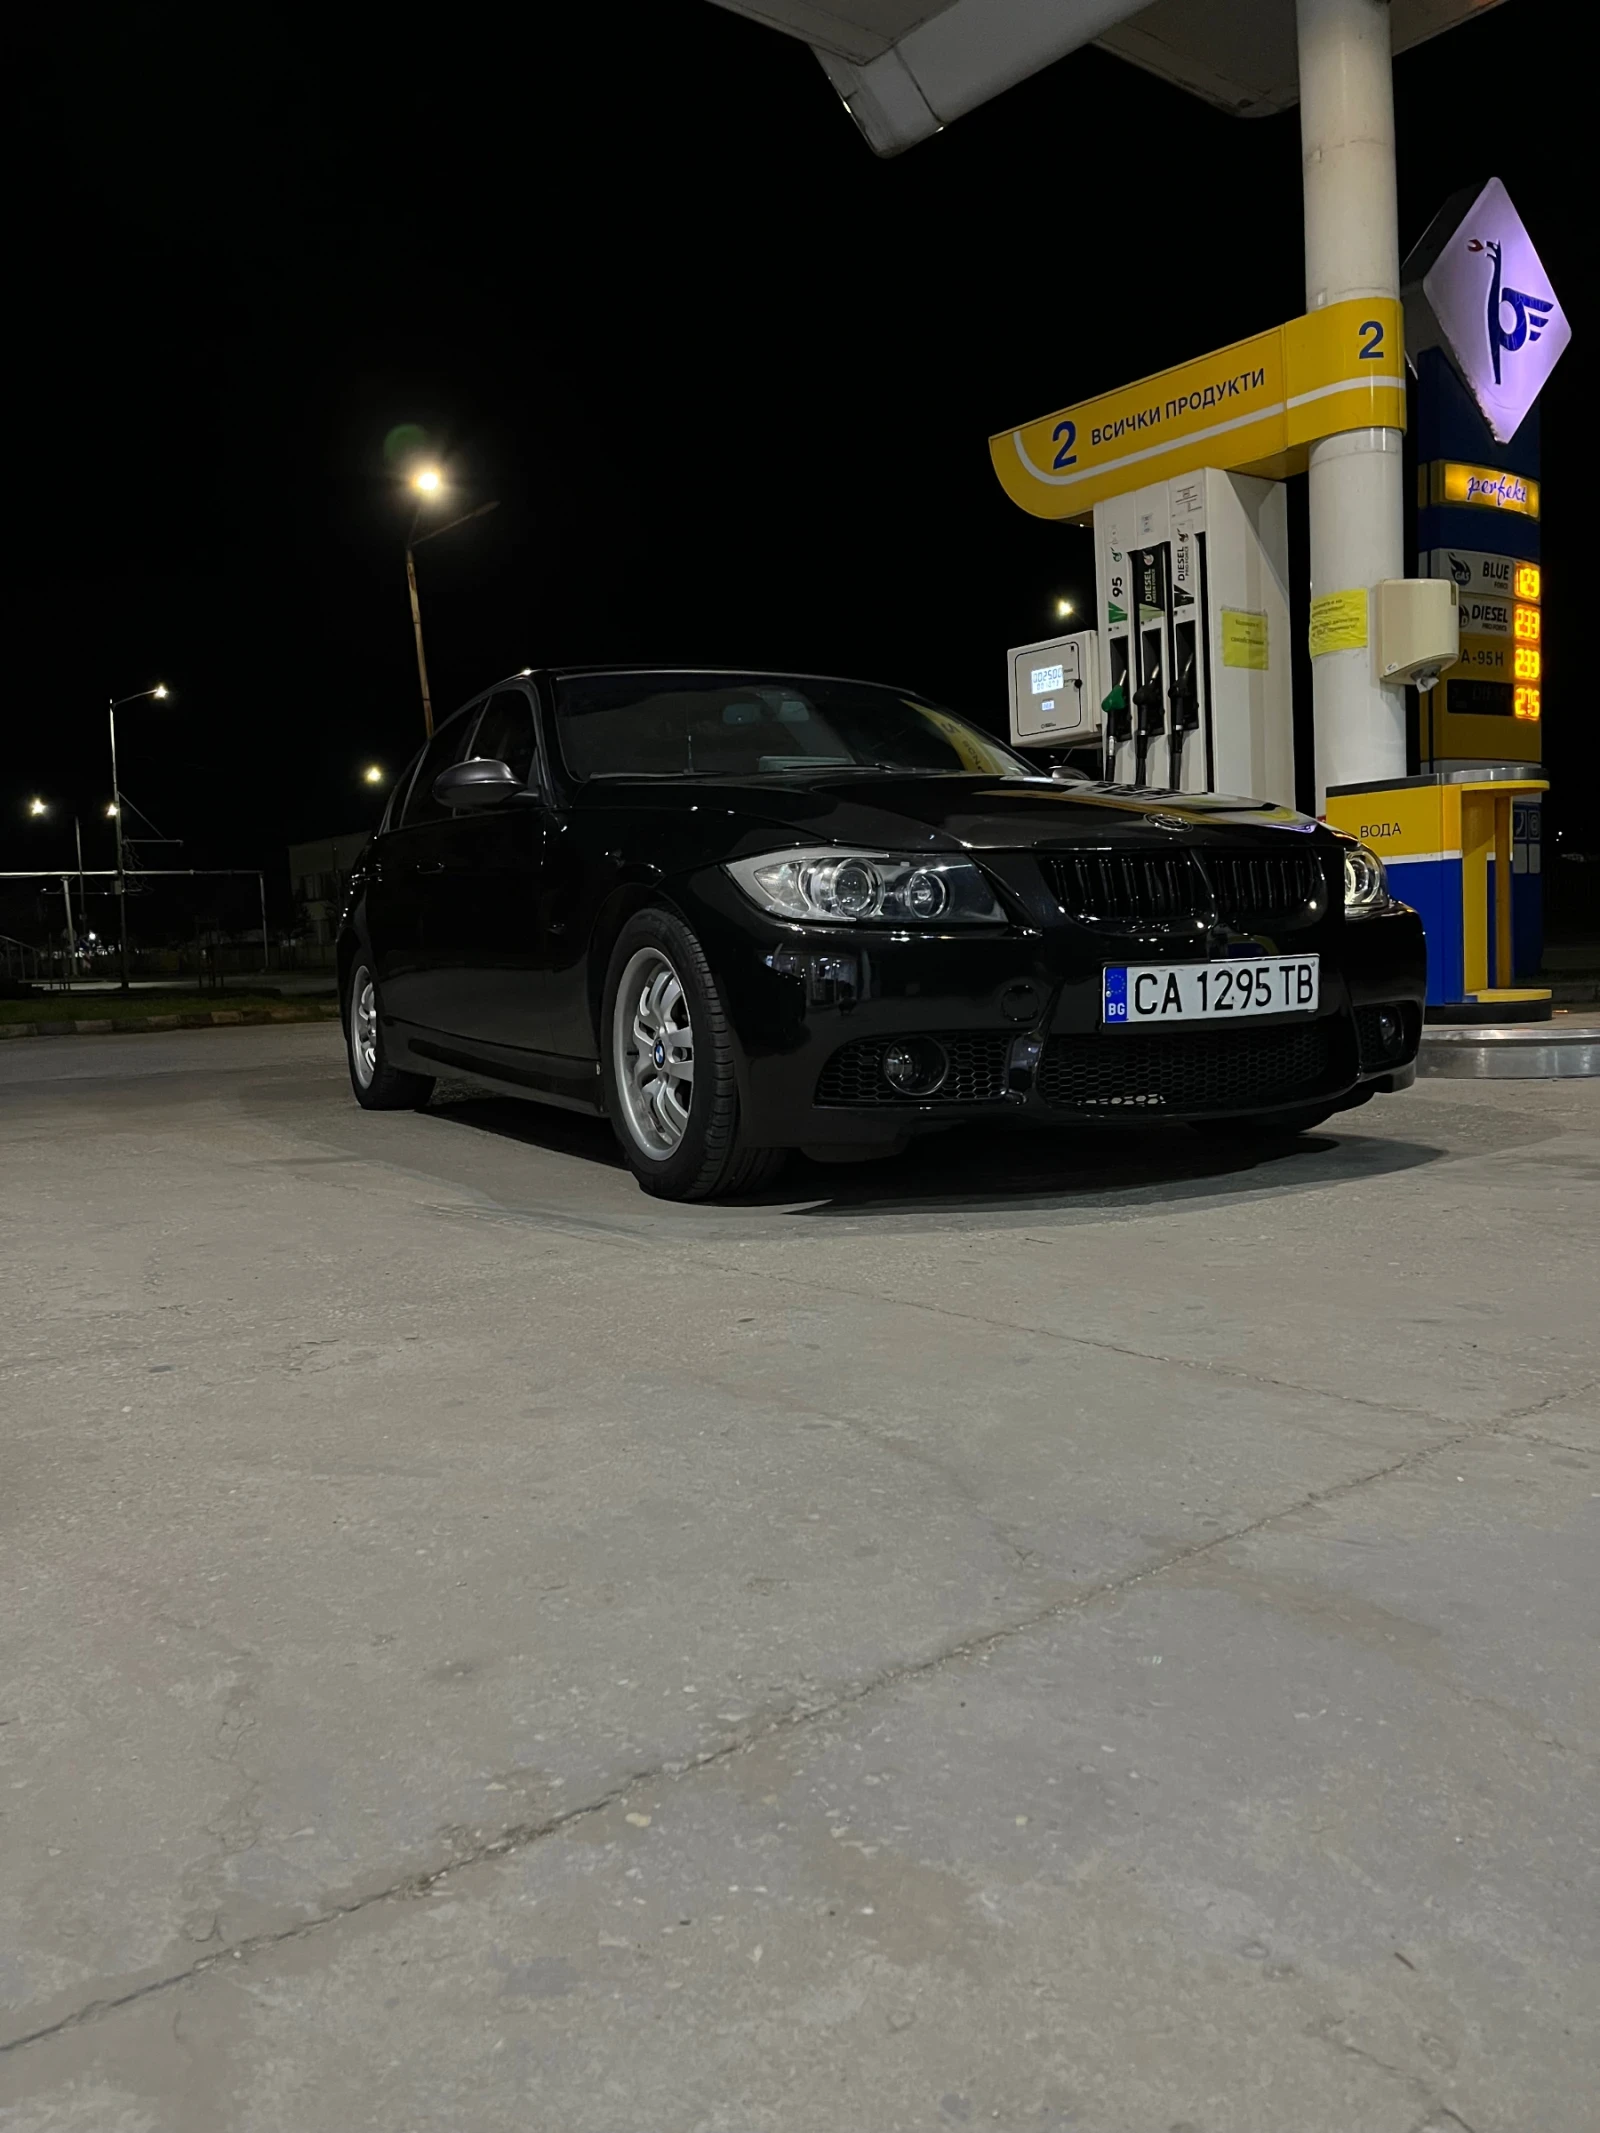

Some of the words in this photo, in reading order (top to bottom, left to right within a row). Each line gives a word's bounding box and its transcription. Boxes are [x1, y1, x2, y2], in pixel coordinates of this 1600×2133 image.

[1358, 320, 1384, 359] 2
[1052, 420, 1077, 469] 2
[1091, 401, 1162, 446] ВСИЧКИ
[1165, 367, 1265, 420] ПРОДУКТИ
[1467, 474, 1527, 505] perfekt
[1177, 546, 1185, 581] DIESEL
[1455, 571, 1470, 581] GAS
[1483, 561, 1510, 580] BLUE
[1112, 576, 1123, 597] 95
[1144, 568, 1153, 602] DIESEL
[1472, 605, 1508, 624] DIESEL
[1360, 822, 1402, 838] ВОДА
[1108, 1003, 1125, 1016] BG
[1135, 972, 1182, 1015] CA
[1197, 967, 1272, 1012] 1295
[1279, 964, 1313, 1005] TB
